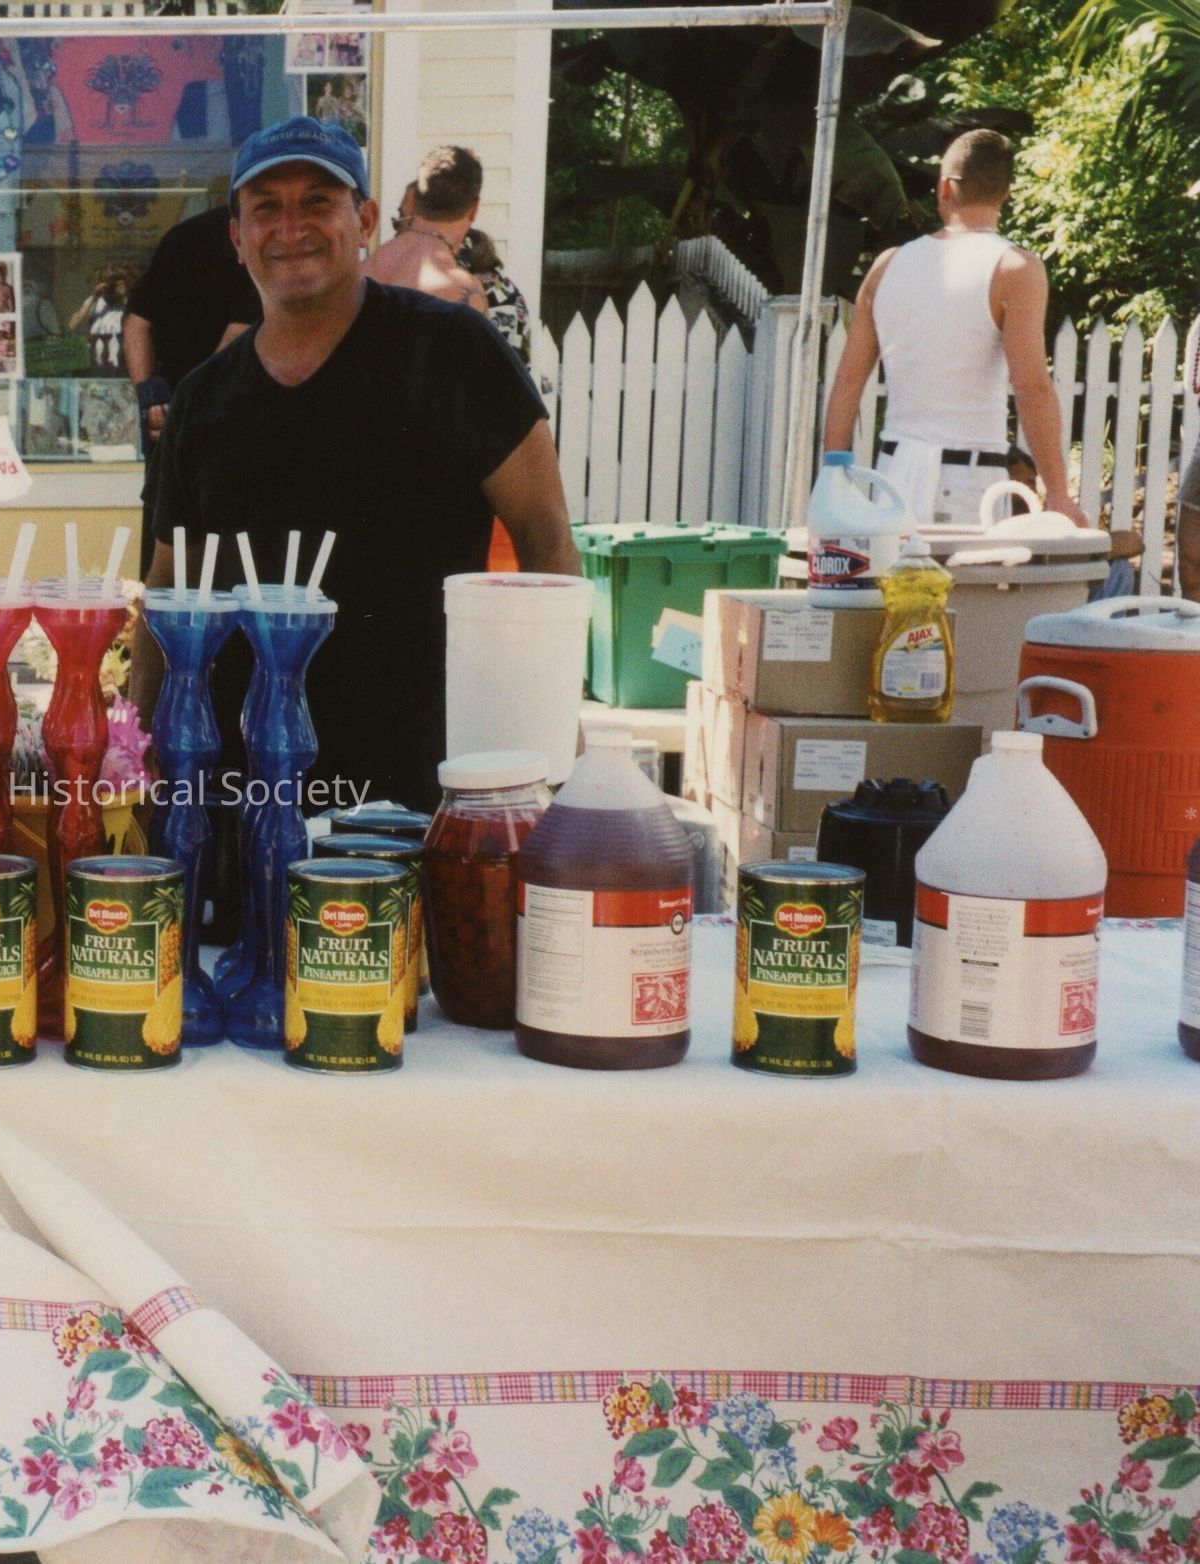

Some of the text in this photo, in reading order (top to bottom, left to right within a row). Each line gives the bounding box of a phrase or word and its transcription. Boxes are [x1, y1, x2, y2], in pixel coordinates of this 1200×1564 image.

[811, 556, 851, 575] CLOROX
[907, 626, 934, 644] AJAX
[88, 908, 128, 920] Del Monte
[324, 911, 365, 921] Del Monte
[778, 912, 823, 923] Del Monte
[84, 934, 136, 950] FRUIT
[318, 937, 372, 951] FRUIT
[772, 938, 830, 953] FRUIT
[71, 944, 154, 967] NATURALS
[300, 947, 388, 967] NATURALS
[753, 949, 846, 970] NATURALS
[73, 963, 150, 982] PINEAPPLE JUICE
[304, 966, 384, 984] PINEAPPLE JUICE
[756, 967, 842, 986] PINEAPPLE JUICE
